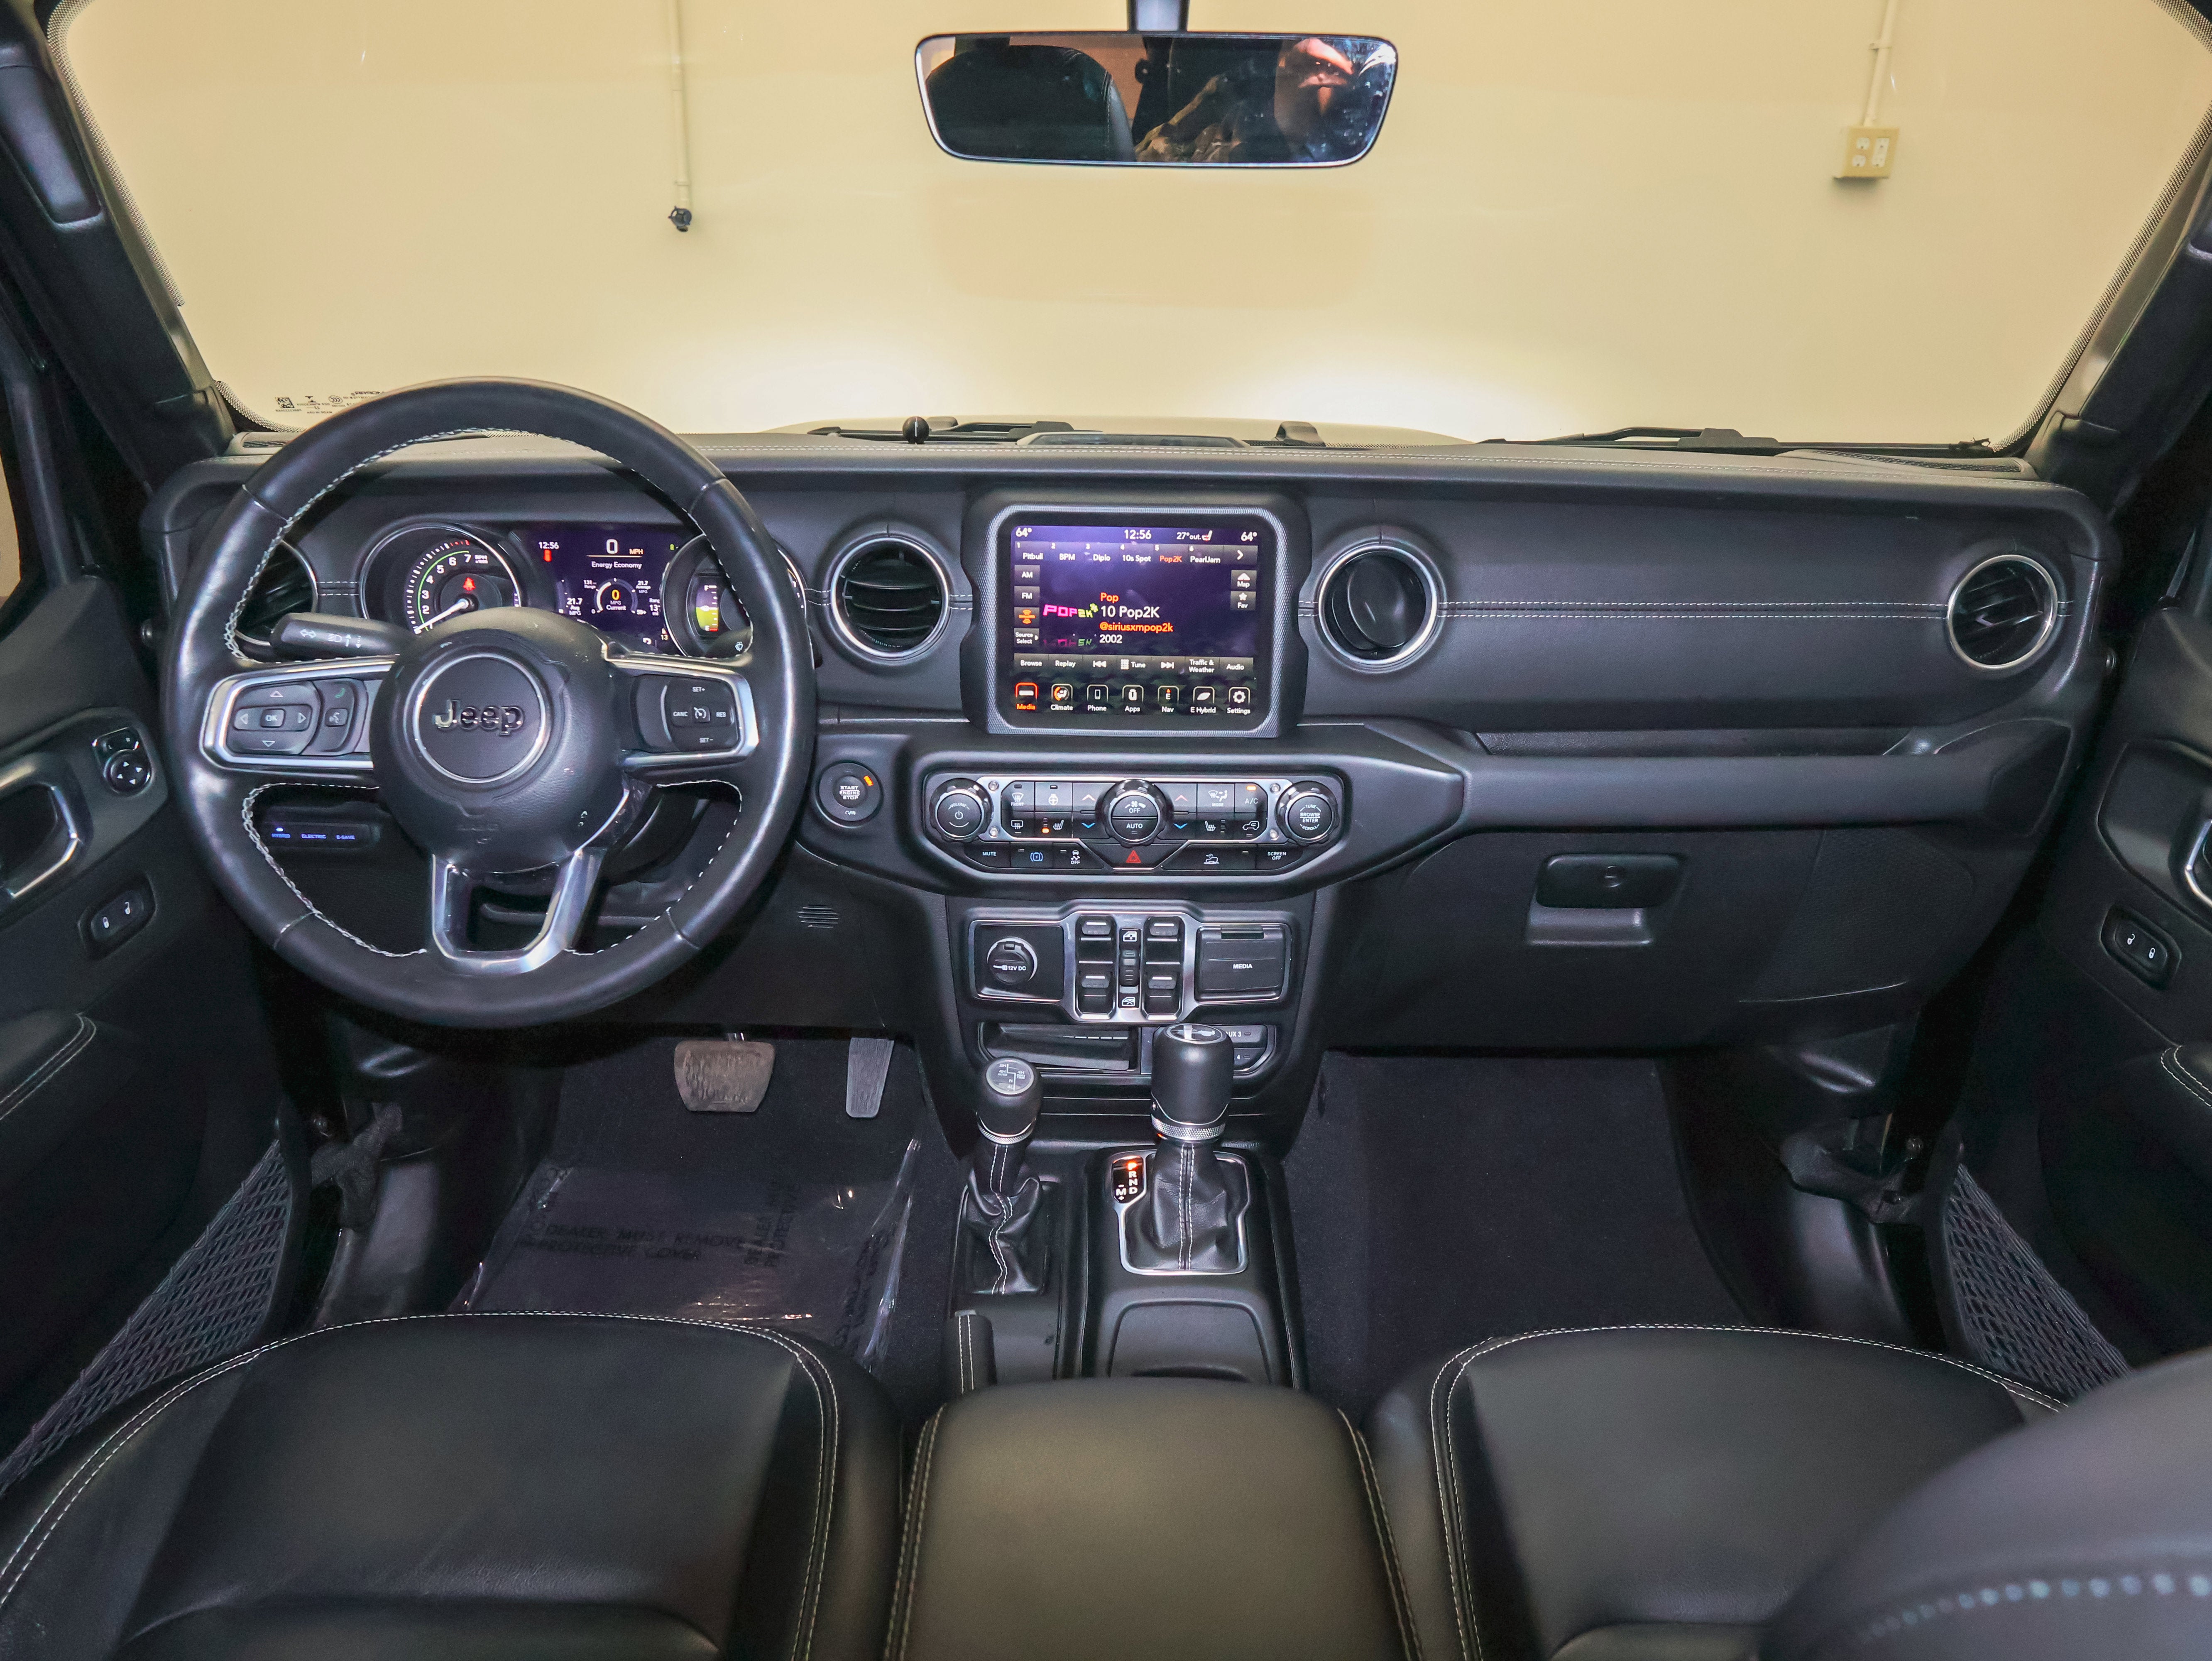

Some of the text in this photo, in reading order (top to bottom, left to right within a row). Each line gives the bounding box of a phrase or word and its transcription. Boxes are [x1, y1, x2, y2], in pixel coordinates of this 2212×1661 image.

[1015, 527, 1032, 537] 64°
[1124, 529, 1152, 539] 12:56
[1241, 532, 1257, 541] 64°
[606, 539, 619, 554] 0
[449, 557, 457, 566] 6
[464, 554, 472, 563] 7
[1093, 554, 1111, 562] Diplo
[436, 565, 444, 573] 5
[426, 575, 434, 584] 4
[421, 590, 429, 599] 3
[611, 589, 621, 600] 0
[1100, 592, 1119, 603] Pop
[422, 605, 430, 615] 2
[1101, 605, 1160, 620] 10 Pop2K
[1099, 622, 1174, 633] @siriusxmpop2k
[1099, 634, 1123, 644] 2002
[265, 714, 279, 723] OK
[434, 699, 524, 736] Jeep
